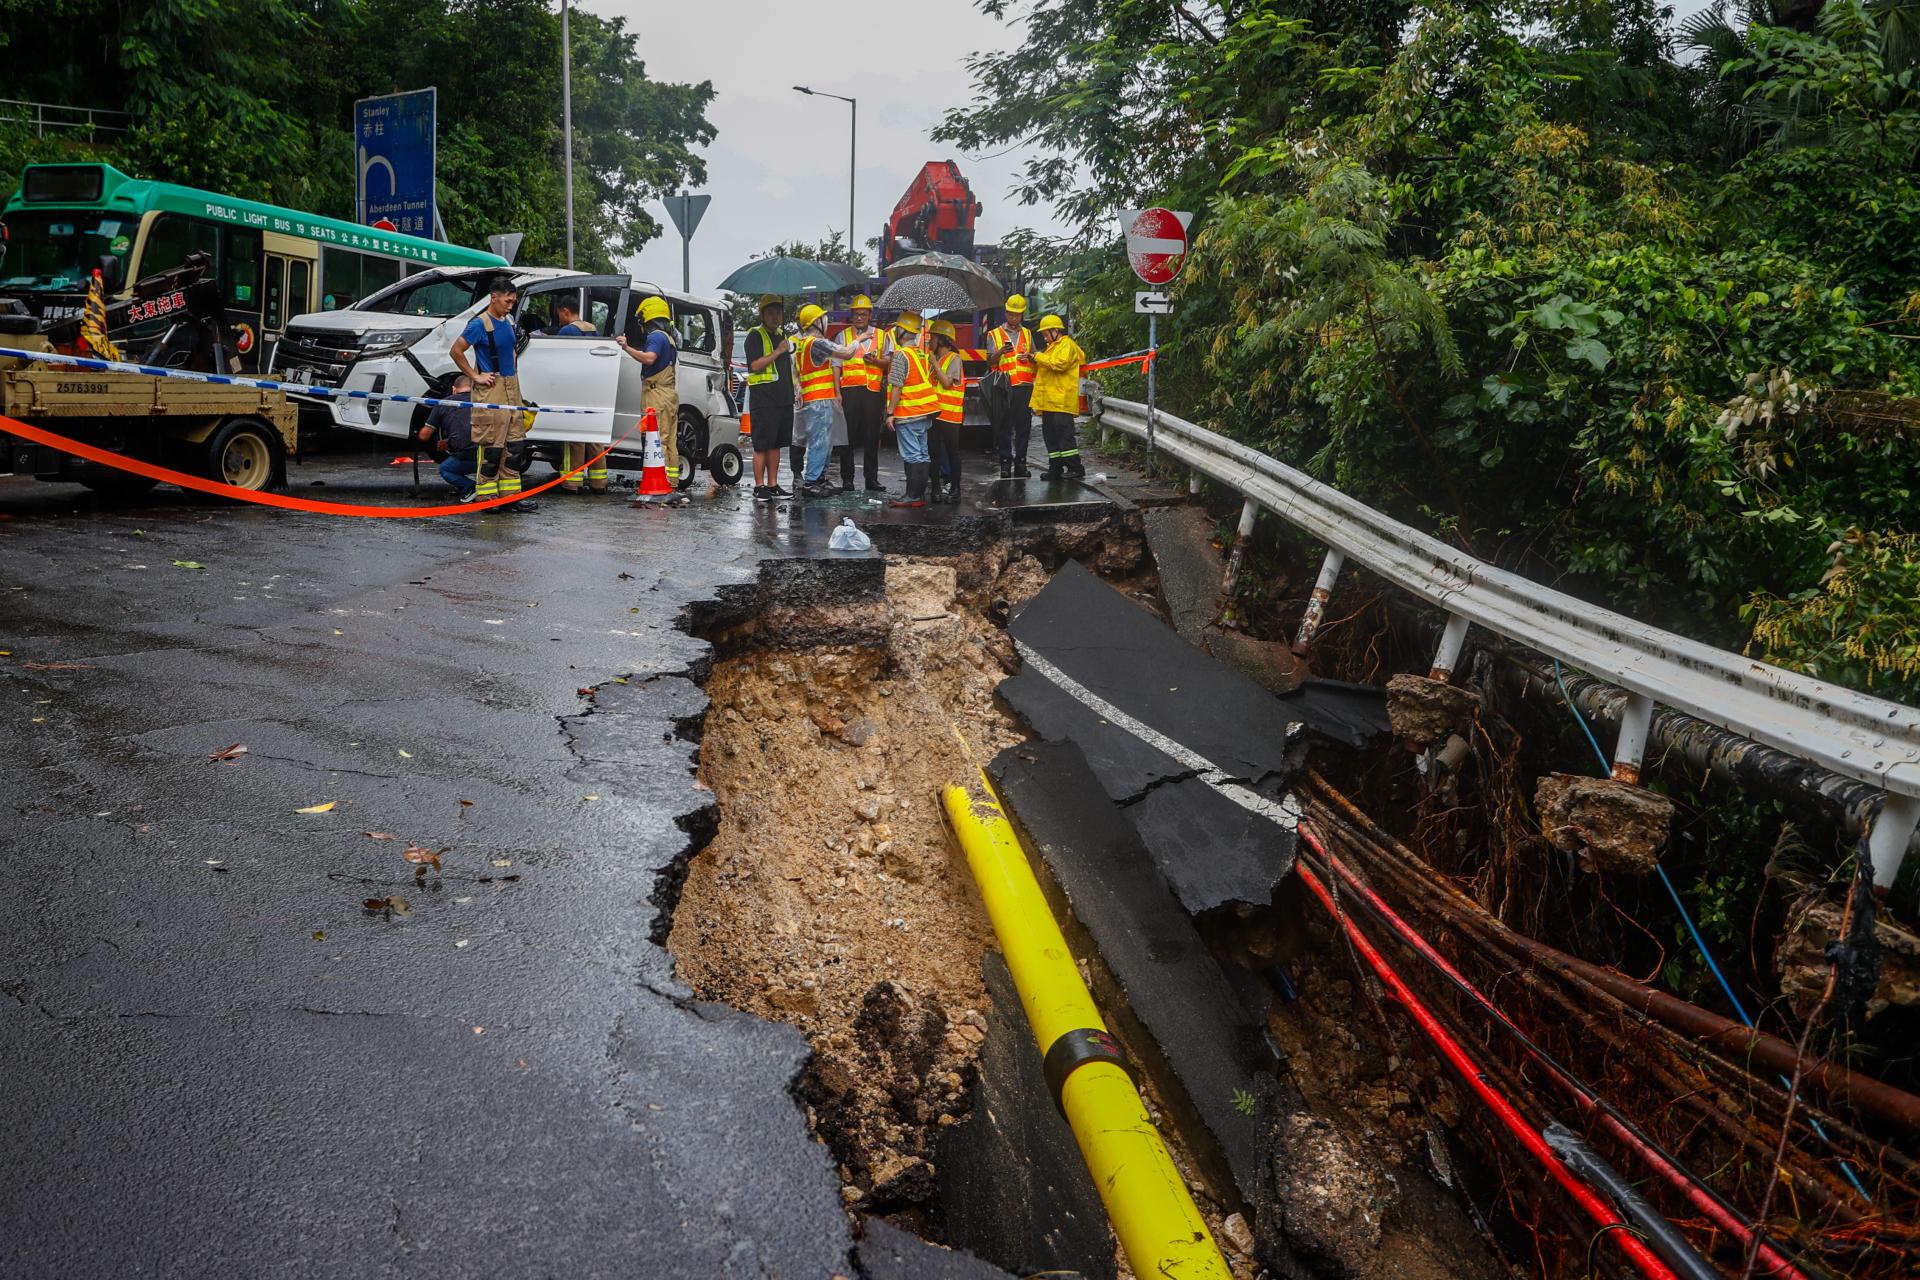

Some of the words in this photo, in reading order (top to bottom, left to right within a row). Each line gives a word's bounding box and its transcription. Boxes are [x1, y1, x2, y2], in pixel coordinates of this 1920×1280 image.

[363, 106, 390, 118] Stanley
[363, 121, 385, 138] 赤柱
[369, 202, 402, 214] Aberdeen
[403, 200, 427, 211] Tunnel
[206, 203, 237, 220] PUBLIC
[243, 211, 267, 226] LIGHT
[274, 218, 290, 231] BUS
[296, 223, 304, 234] 19
[310, 226, 336, 240] SEATS
[127, 292, 186, 323] 大東拖車
[56, 383, 109, 394] 25763991
